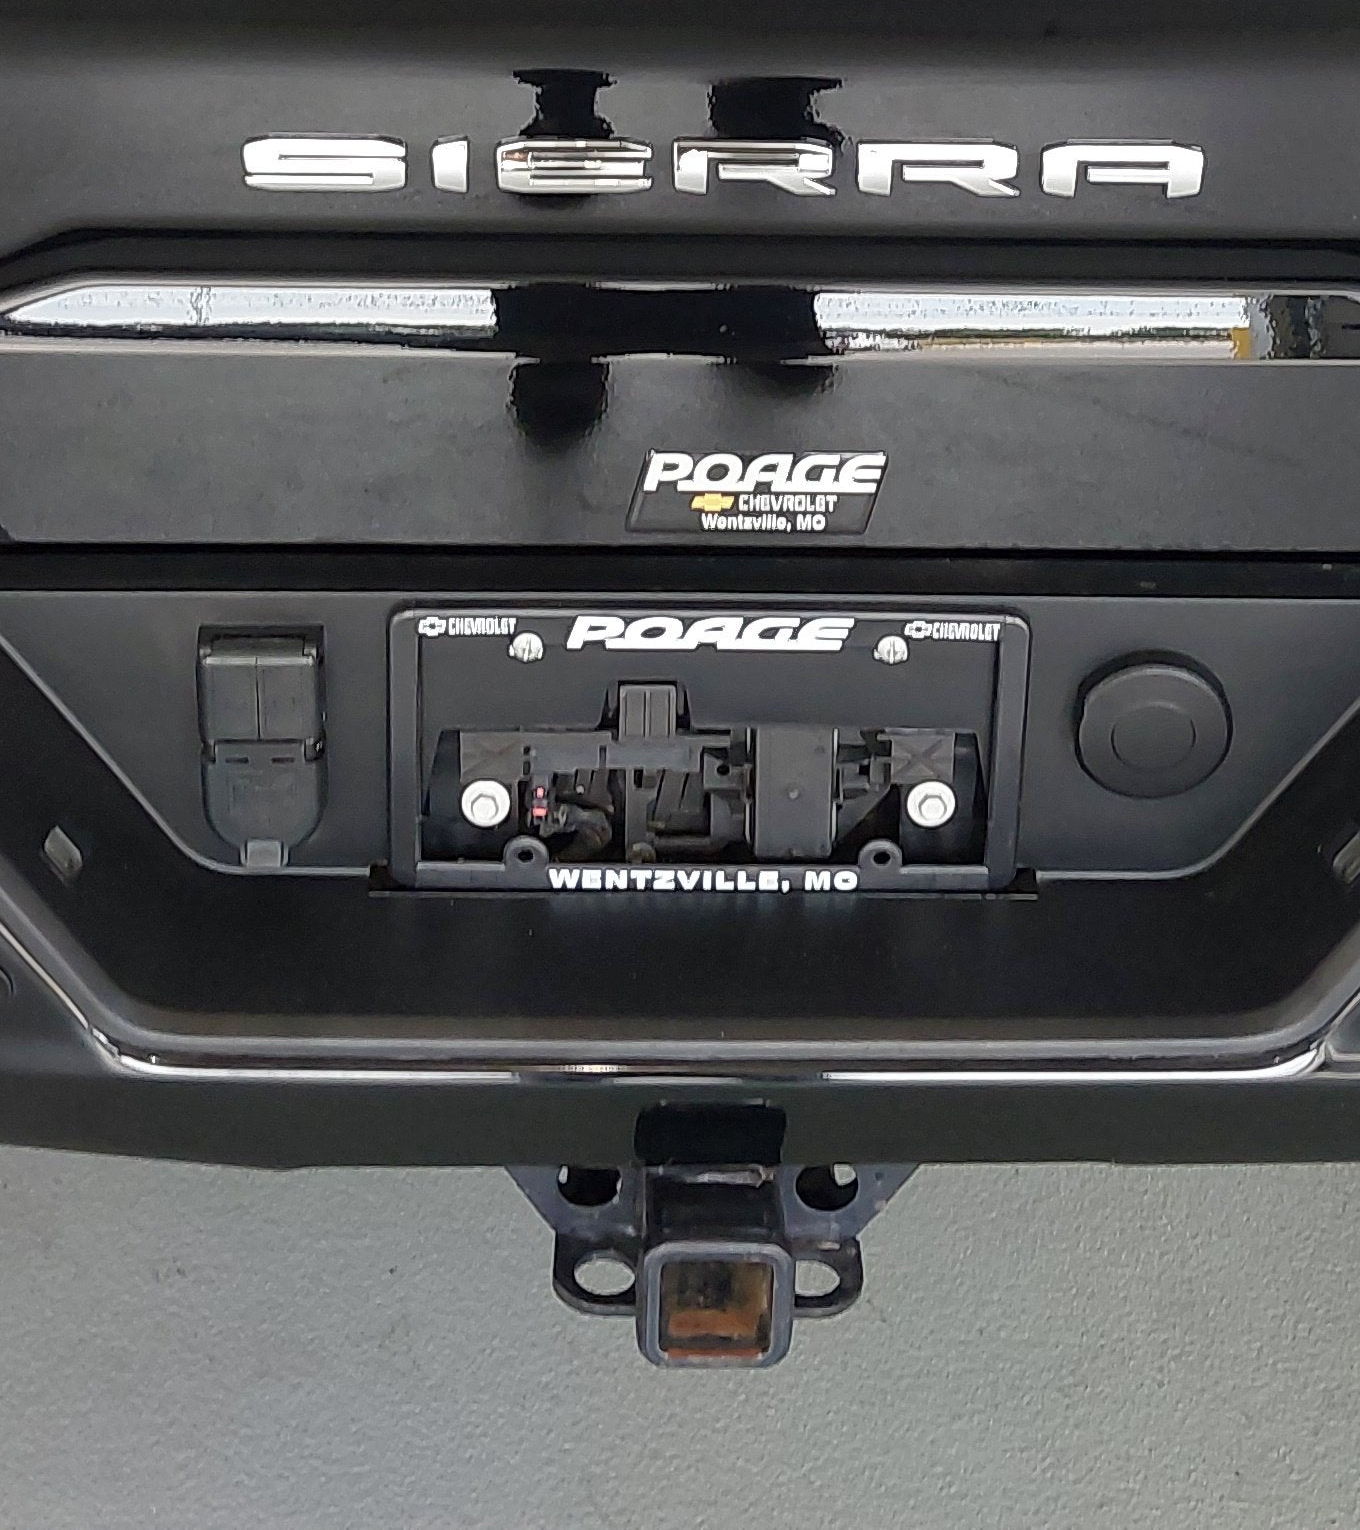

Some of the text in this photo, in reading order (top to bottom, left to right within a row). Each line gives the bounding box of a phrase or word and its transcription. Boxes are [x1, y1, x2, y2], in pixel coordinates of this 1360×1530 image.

[240, 131, 1206, 199] SIERRA
[643, 451, 887, 493] POAGE
[738, 494, 838, 513] CHEVROLET
[701, 513, 827, 533] Wentzville, MO
[448, 617, 517, 636] CHEVROLET
[566, 615, 855, 651] POAGE
[931, 621, 1001, 642] CHEVROLET
[548, 867, 859, 894] WENTZVILLE, MO
